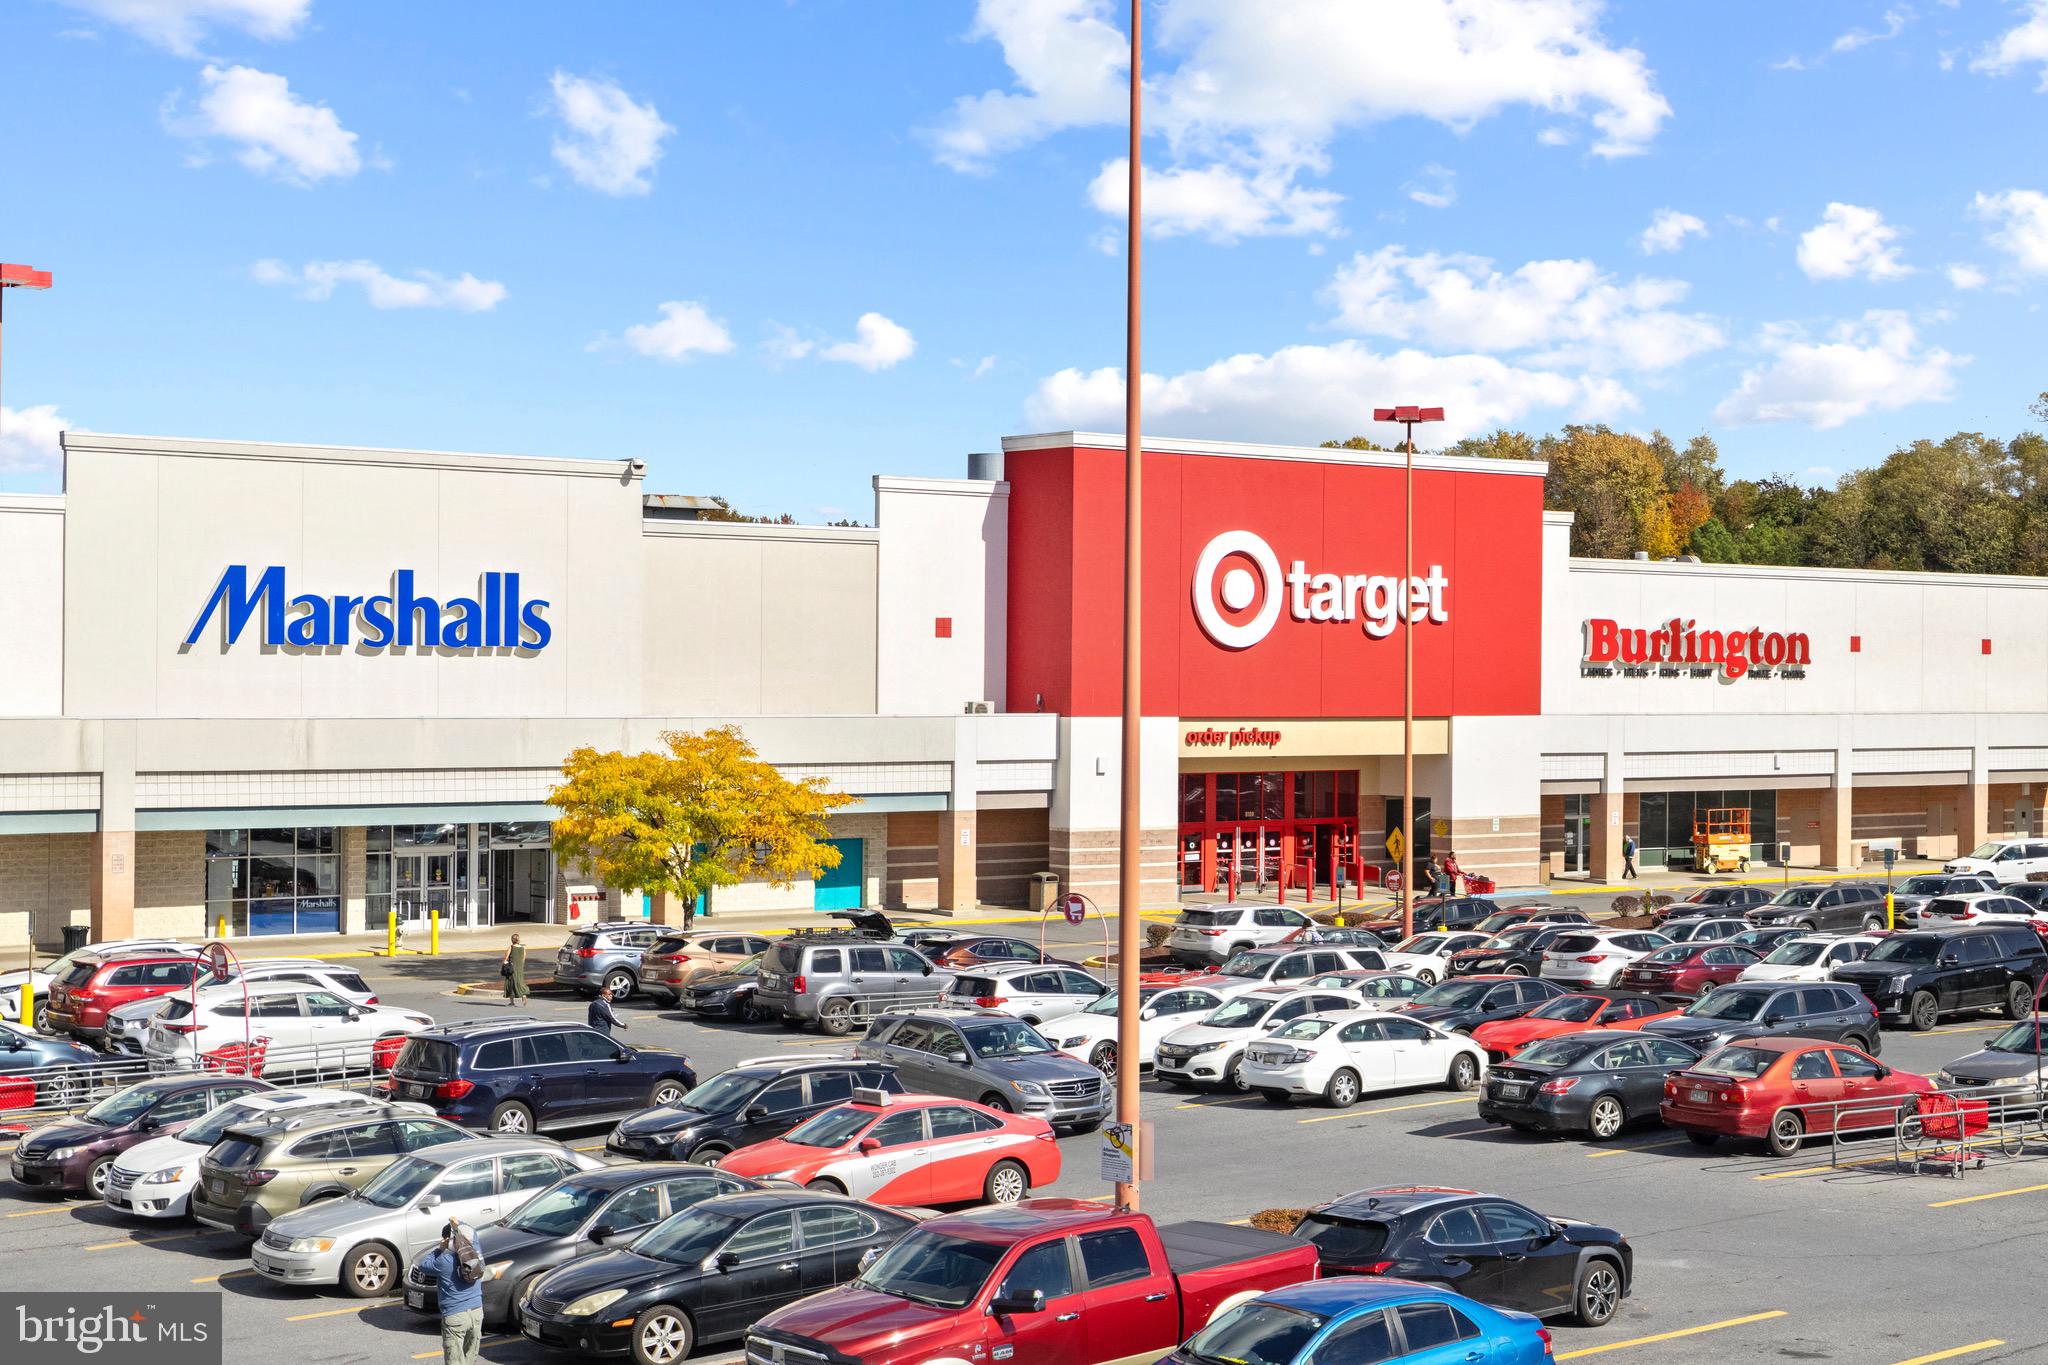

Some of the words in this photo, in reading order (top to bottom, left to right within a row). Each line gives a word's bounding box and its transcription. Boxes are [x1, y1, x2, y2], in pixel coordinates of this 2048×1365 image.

[183, 564, 552, 650] Marshalls
[1286, 560, 1449, 638] target
[1583, 617, 1812, 679] Burlington
[1186, 727, 1229, 746] order
[1230, 727, 1282, 748] pickup
[299, 898, 337, 909] Marshalls
[870, 1160, 889, 1172] WONDER
[888, 1159, 897, 1168] CAB
